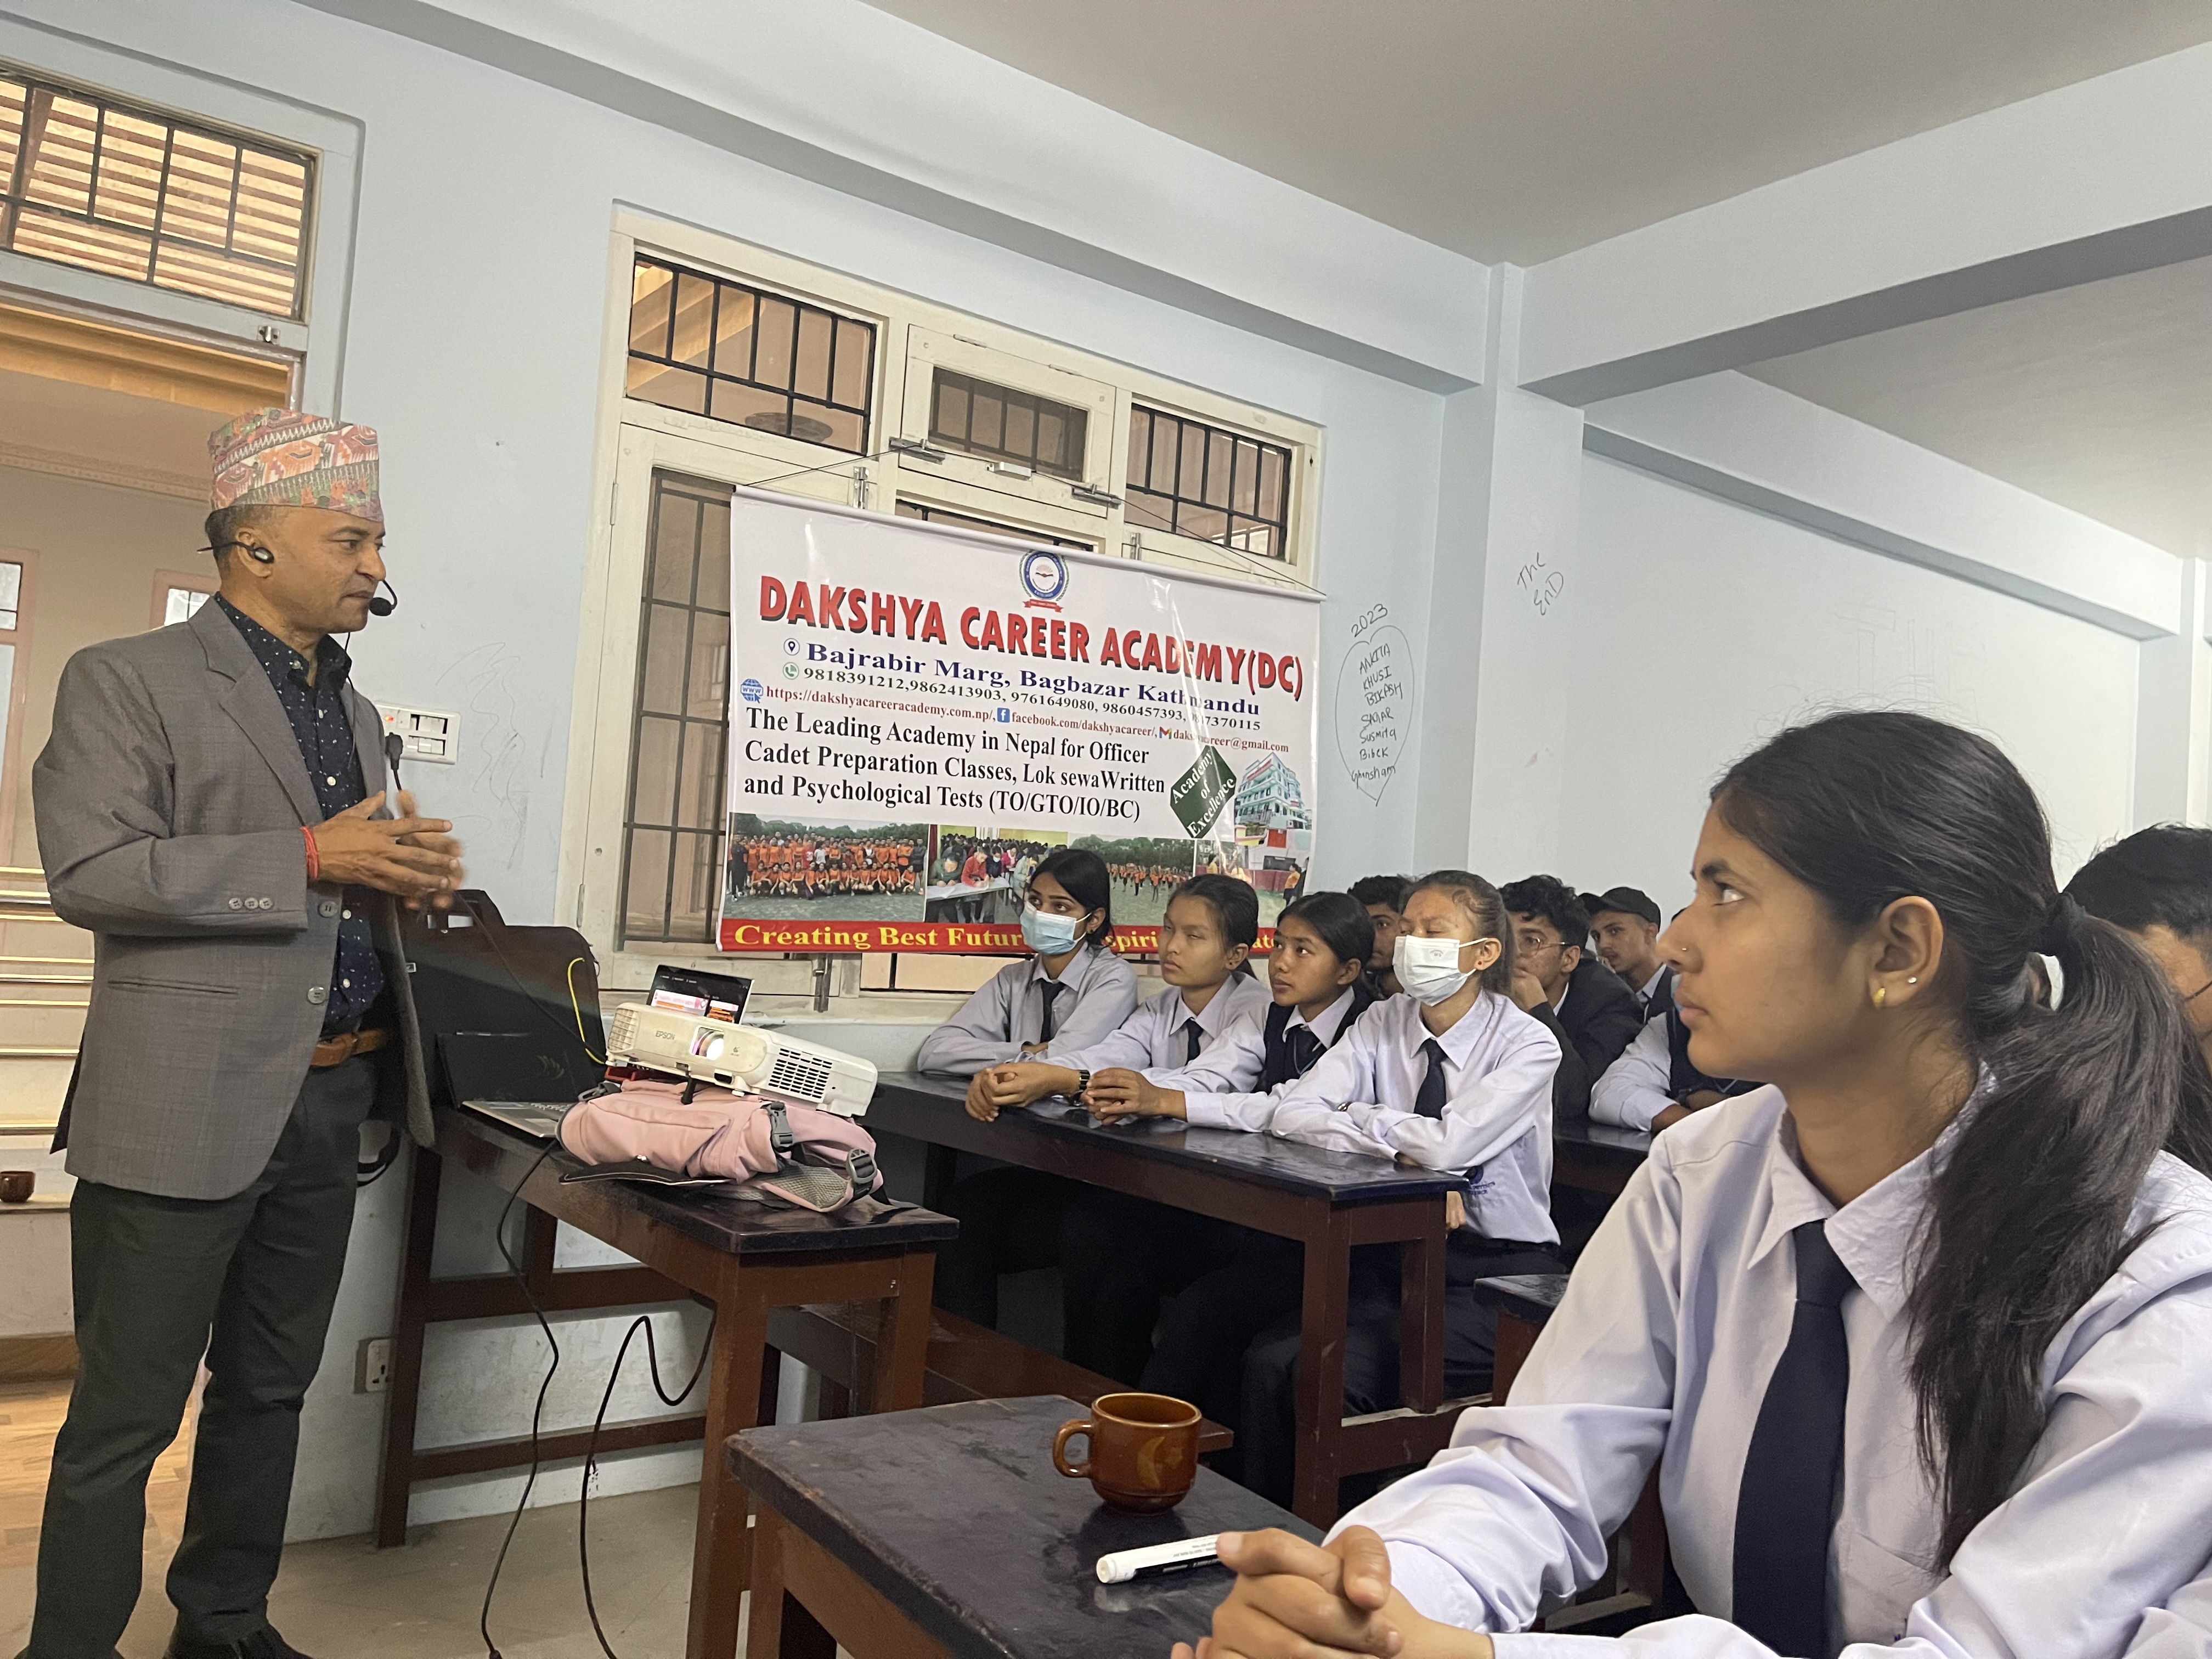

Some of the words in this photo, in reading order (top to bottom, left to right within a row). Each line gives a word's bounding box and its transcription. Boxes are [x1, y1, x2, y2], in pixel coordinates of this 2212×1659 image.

[760, 575, 947, 645] DAKSHYA
[960, 606, 1090, 663] CAREER
[1351, 603, 1388, 637] 2023
[806, 643, 926, 674] Bajrabir
[935, 659, 1011, 688] Marg,
[1019, 670, 1130, 698] Bagbazar
[1363, 665, 1392, 691] KHUSI
[1364, 682, 1403, 706] BIKASH
[746, 707, 788, 731] The
[795, 712, 882, 744] Leading
[886, 721, 976, 753] Academy
[982, 730, 999, 751] in
[1005, 732, 1056, 759] Nepal
[1060, 738, 1085, 758] for
[1090, 741, 1149, 764] Officer
[745, 740, 810, 765] Cadet
[817, 746, 938, 775] Preparation
[945, 757, 1017, 785] Classes,
[1023, 764, 1056, 785] Lok
[1172, 752, 1213, 804] Academy
[744, 775, 784, 795] and
[791, 776, 931, 808] Psychological
[937, 786, 983, 808] Tests
[989, 790, 1140, 823] (TO/GTO/IO/BC)
[1187, 778, 1235, 838] Excellence
[1200, 779, 1211, 799] of
[735, 925, 871, 950] Creating
[878, 927, 938, 946] Best
[946, 928, 1027, 946] Futur
[656, 1030, 676, 1040] EPSON
